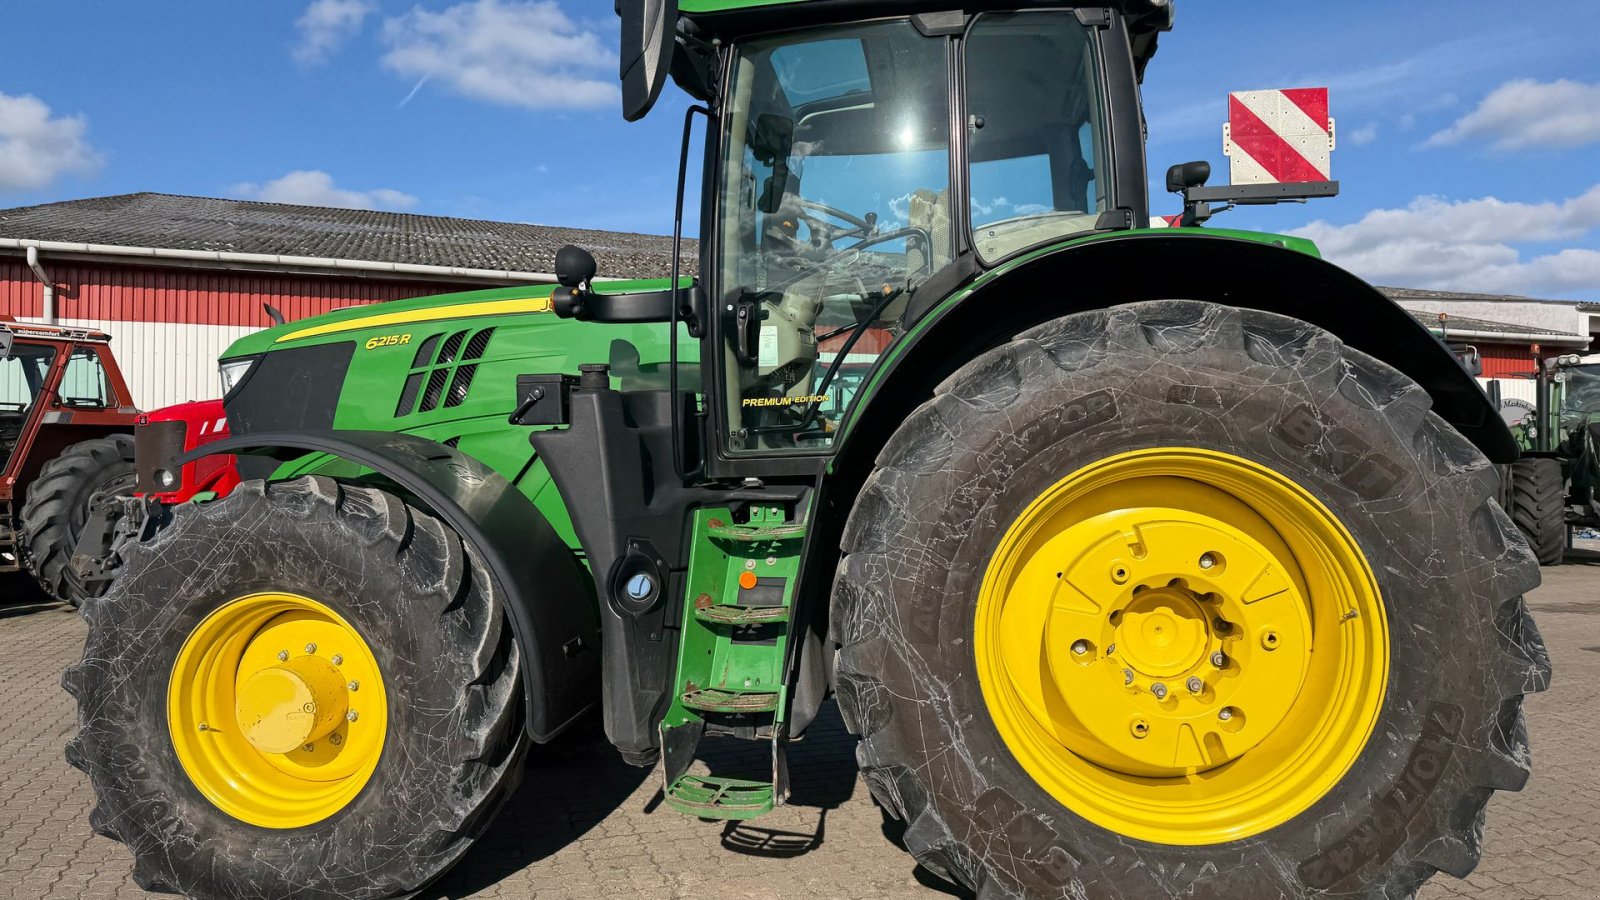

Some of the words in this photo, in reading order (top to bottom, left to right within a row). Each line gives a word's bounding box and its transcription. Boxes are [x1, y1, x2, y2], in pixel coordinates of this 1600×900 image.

[742, 398, 792, 407] PREMIUM
[795, 395, 829, 403] EDITION
[1279, 407, 1397, 489] BKT
